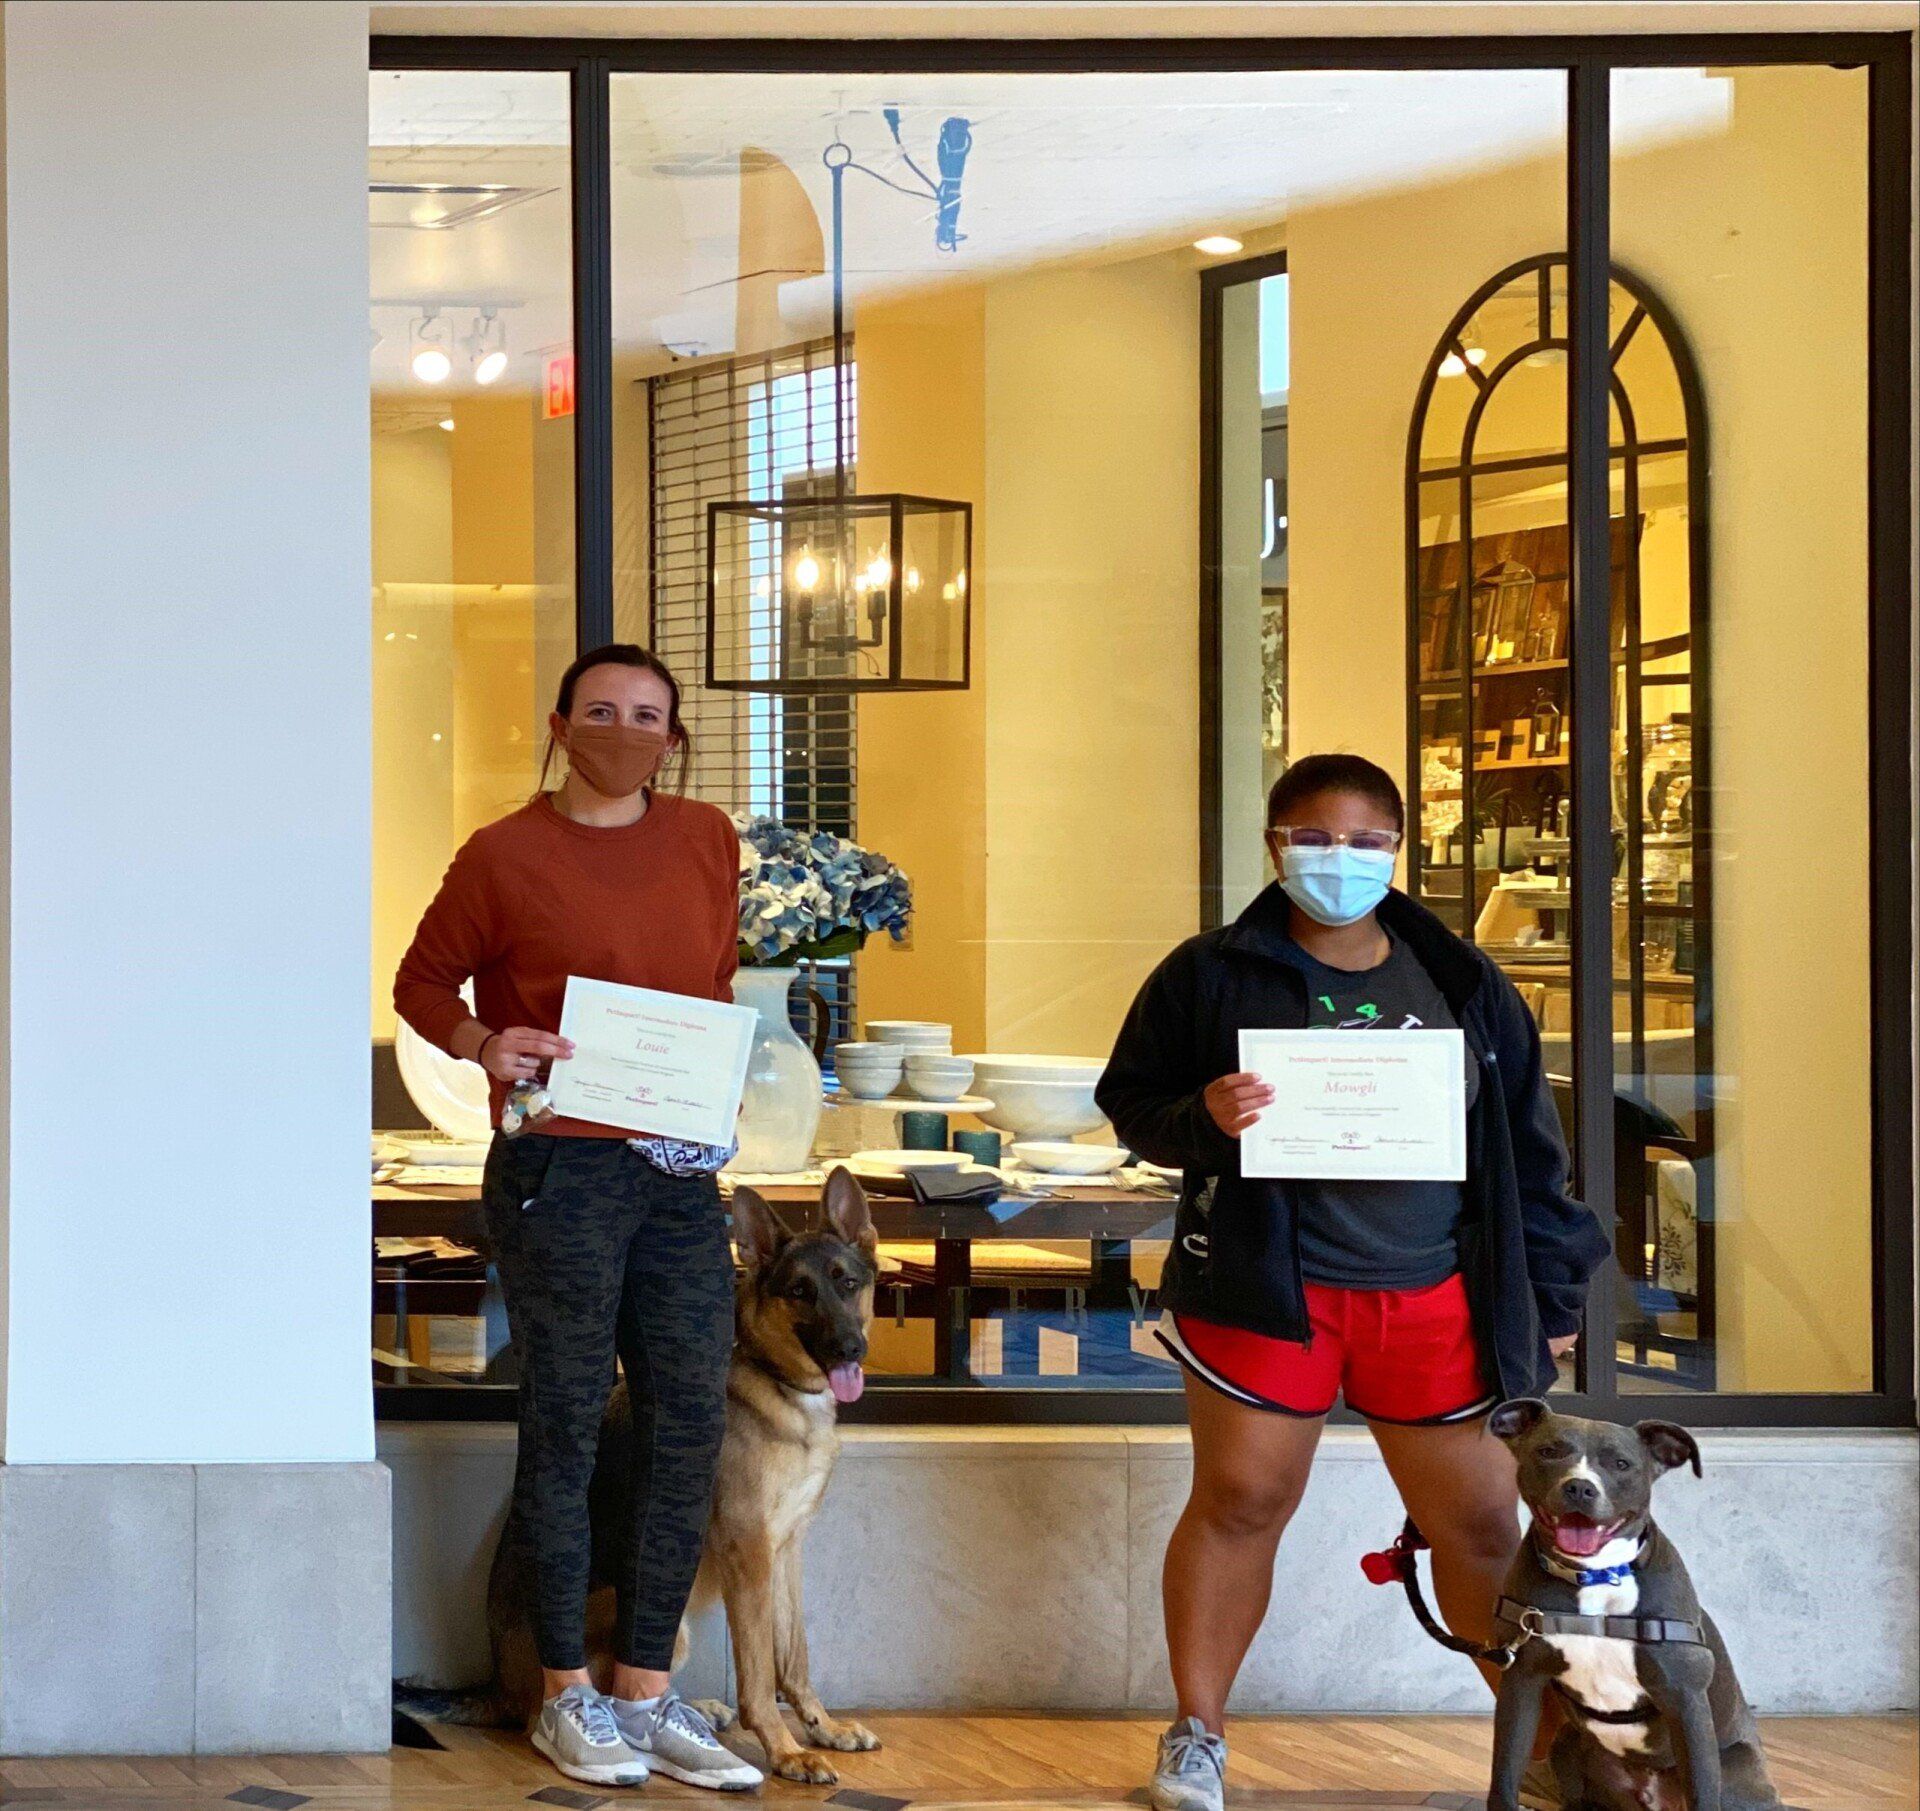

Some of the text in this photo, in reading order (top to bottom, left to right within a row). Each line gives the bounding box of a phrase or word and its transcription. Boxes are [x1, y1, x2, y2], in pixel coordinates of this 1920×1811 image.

[635, 1038, 670, 1055] Louie
[1324, 1081, 1378, 1097] Mowgli
[888, 1285, 1151, 1330] TTERY
